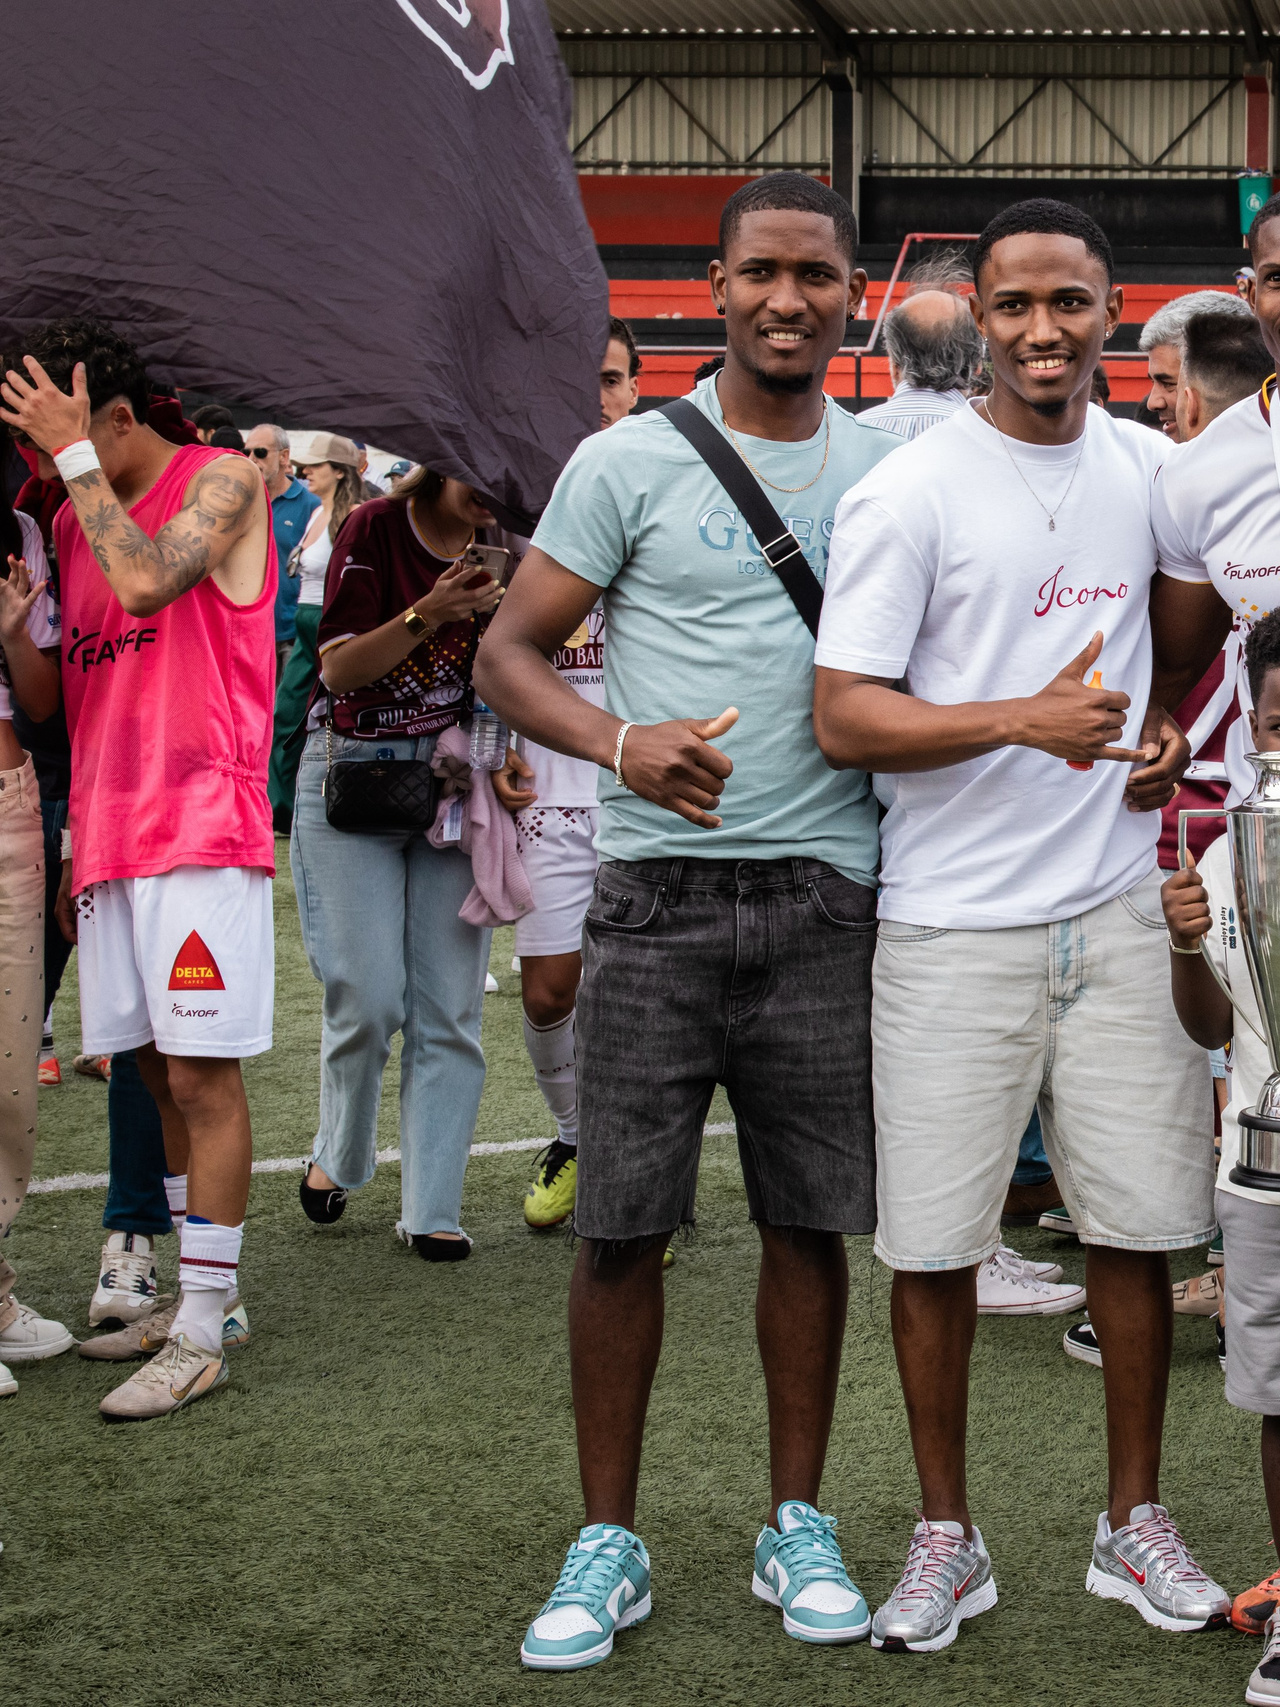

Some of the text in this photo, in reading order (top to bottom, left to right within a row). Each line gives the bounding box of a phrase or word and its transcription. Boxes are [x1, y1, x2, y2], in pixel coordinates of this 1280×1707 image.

[738, 560, 765, 575] LOS
[176, 967, 214, 978] DELTA
[175, 1009, 219, 1017] PLAYOFF
